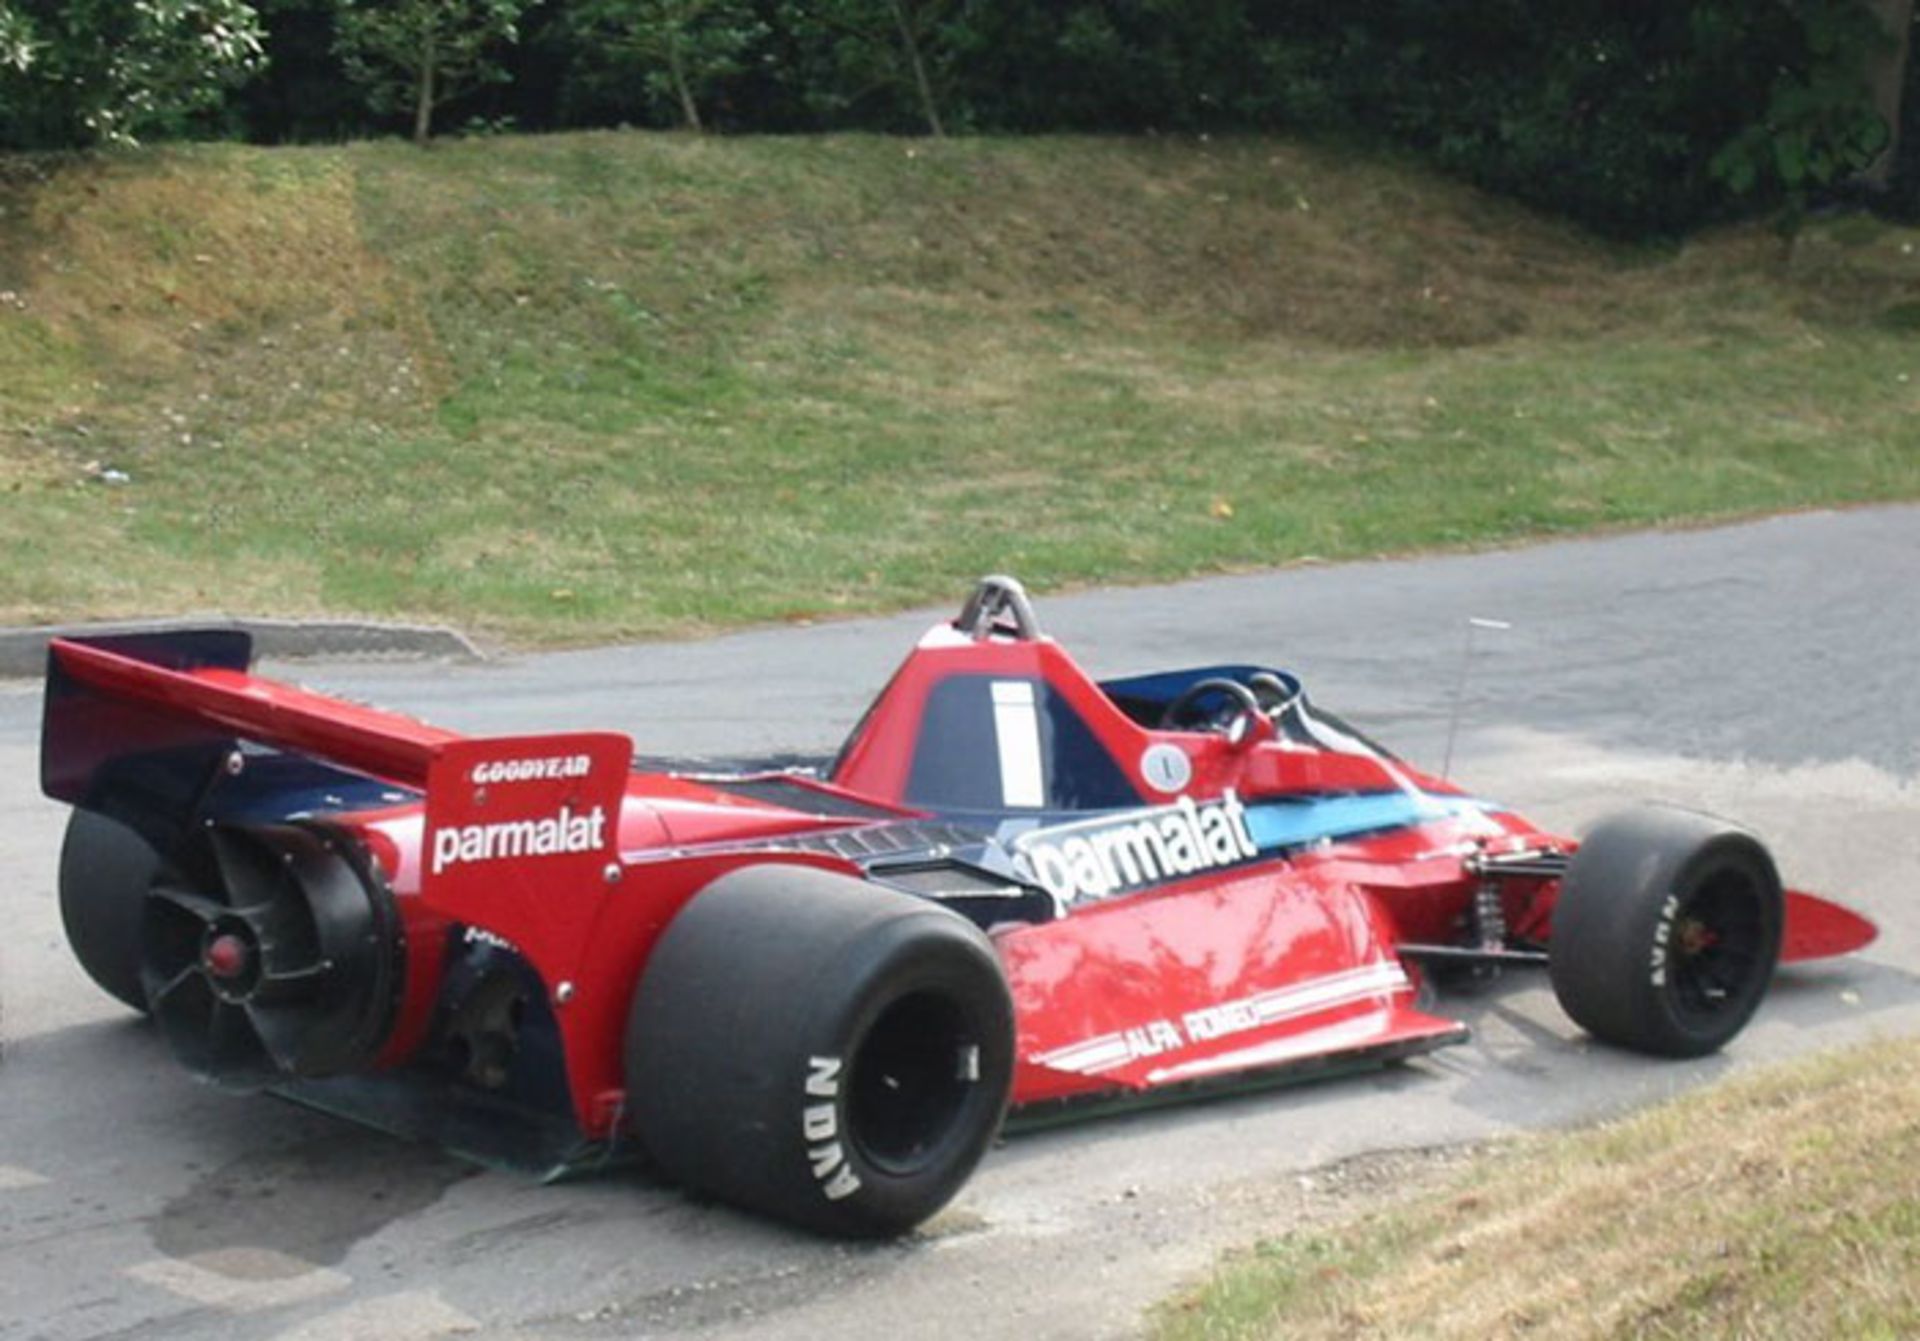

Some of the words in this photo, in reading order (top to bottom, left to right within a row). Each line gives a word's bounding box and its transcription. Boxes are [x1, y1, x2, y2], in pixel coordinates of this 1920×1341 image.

[472, 755, 590, 782] GOODYEAR
[990, 681, 1044, 807] 1
[432, 806, 605, 874] parmalat
[1031, 788, 1257, 919] parmalat
[1124, 1020, 1183, 1059] ALFA
[804, 1056, 861, 1199] AVON
